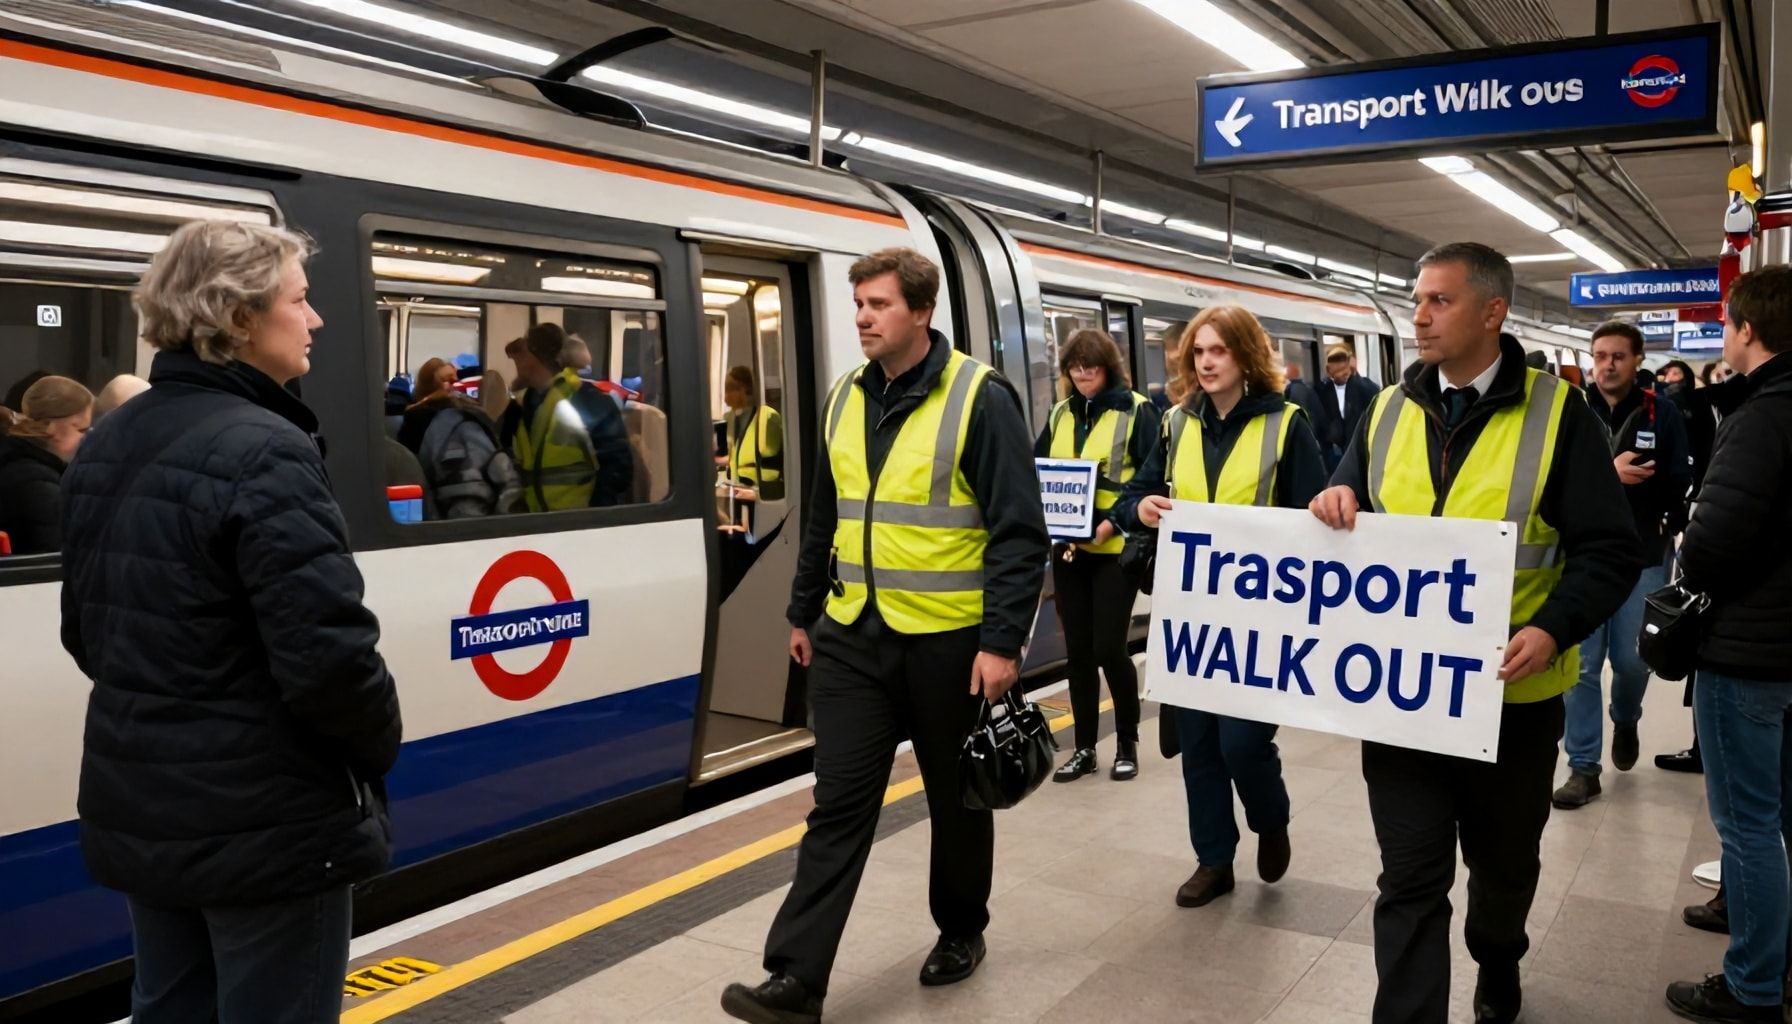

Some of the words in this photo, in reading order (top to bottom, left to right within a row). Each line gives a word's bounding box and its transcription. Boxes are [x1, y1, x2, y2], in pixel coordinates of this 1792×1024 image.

[1272, 88, 1427, 129] Transport
[1520, 78, 1584, 106] ous
[1171, 531, 1476, 625] Trasport
[1163, 619, 1319, 696] WALK
[1334, 643, 1483, 718] OUT
